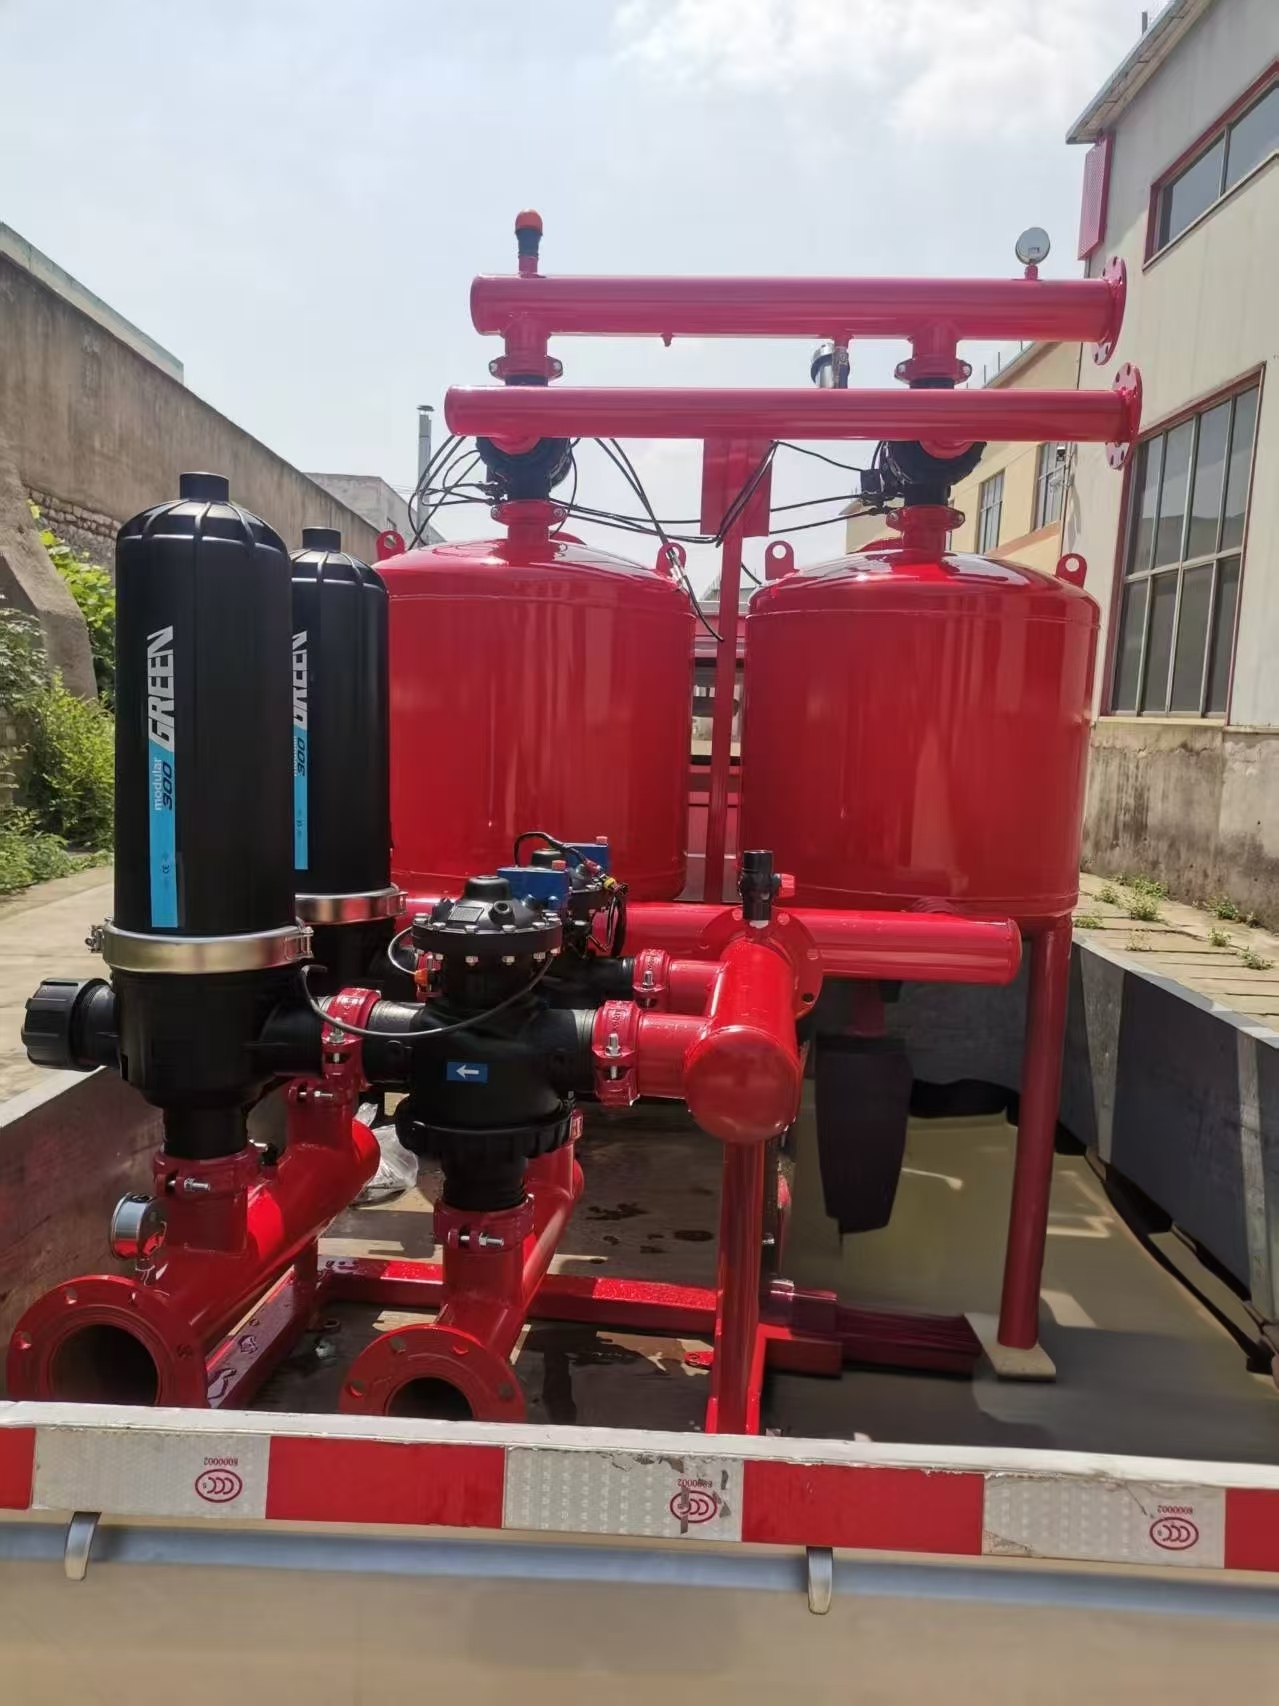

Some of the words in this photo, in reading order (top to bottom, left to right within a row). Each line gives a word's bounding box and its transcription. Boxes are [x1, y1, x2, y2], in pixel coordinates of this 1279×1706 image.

[147, 625, 174, 753] GREEN
[297, 736, 306, 777] 300
[151, 756, 162, 811] modular
[162, 761, 173, 811] 300
